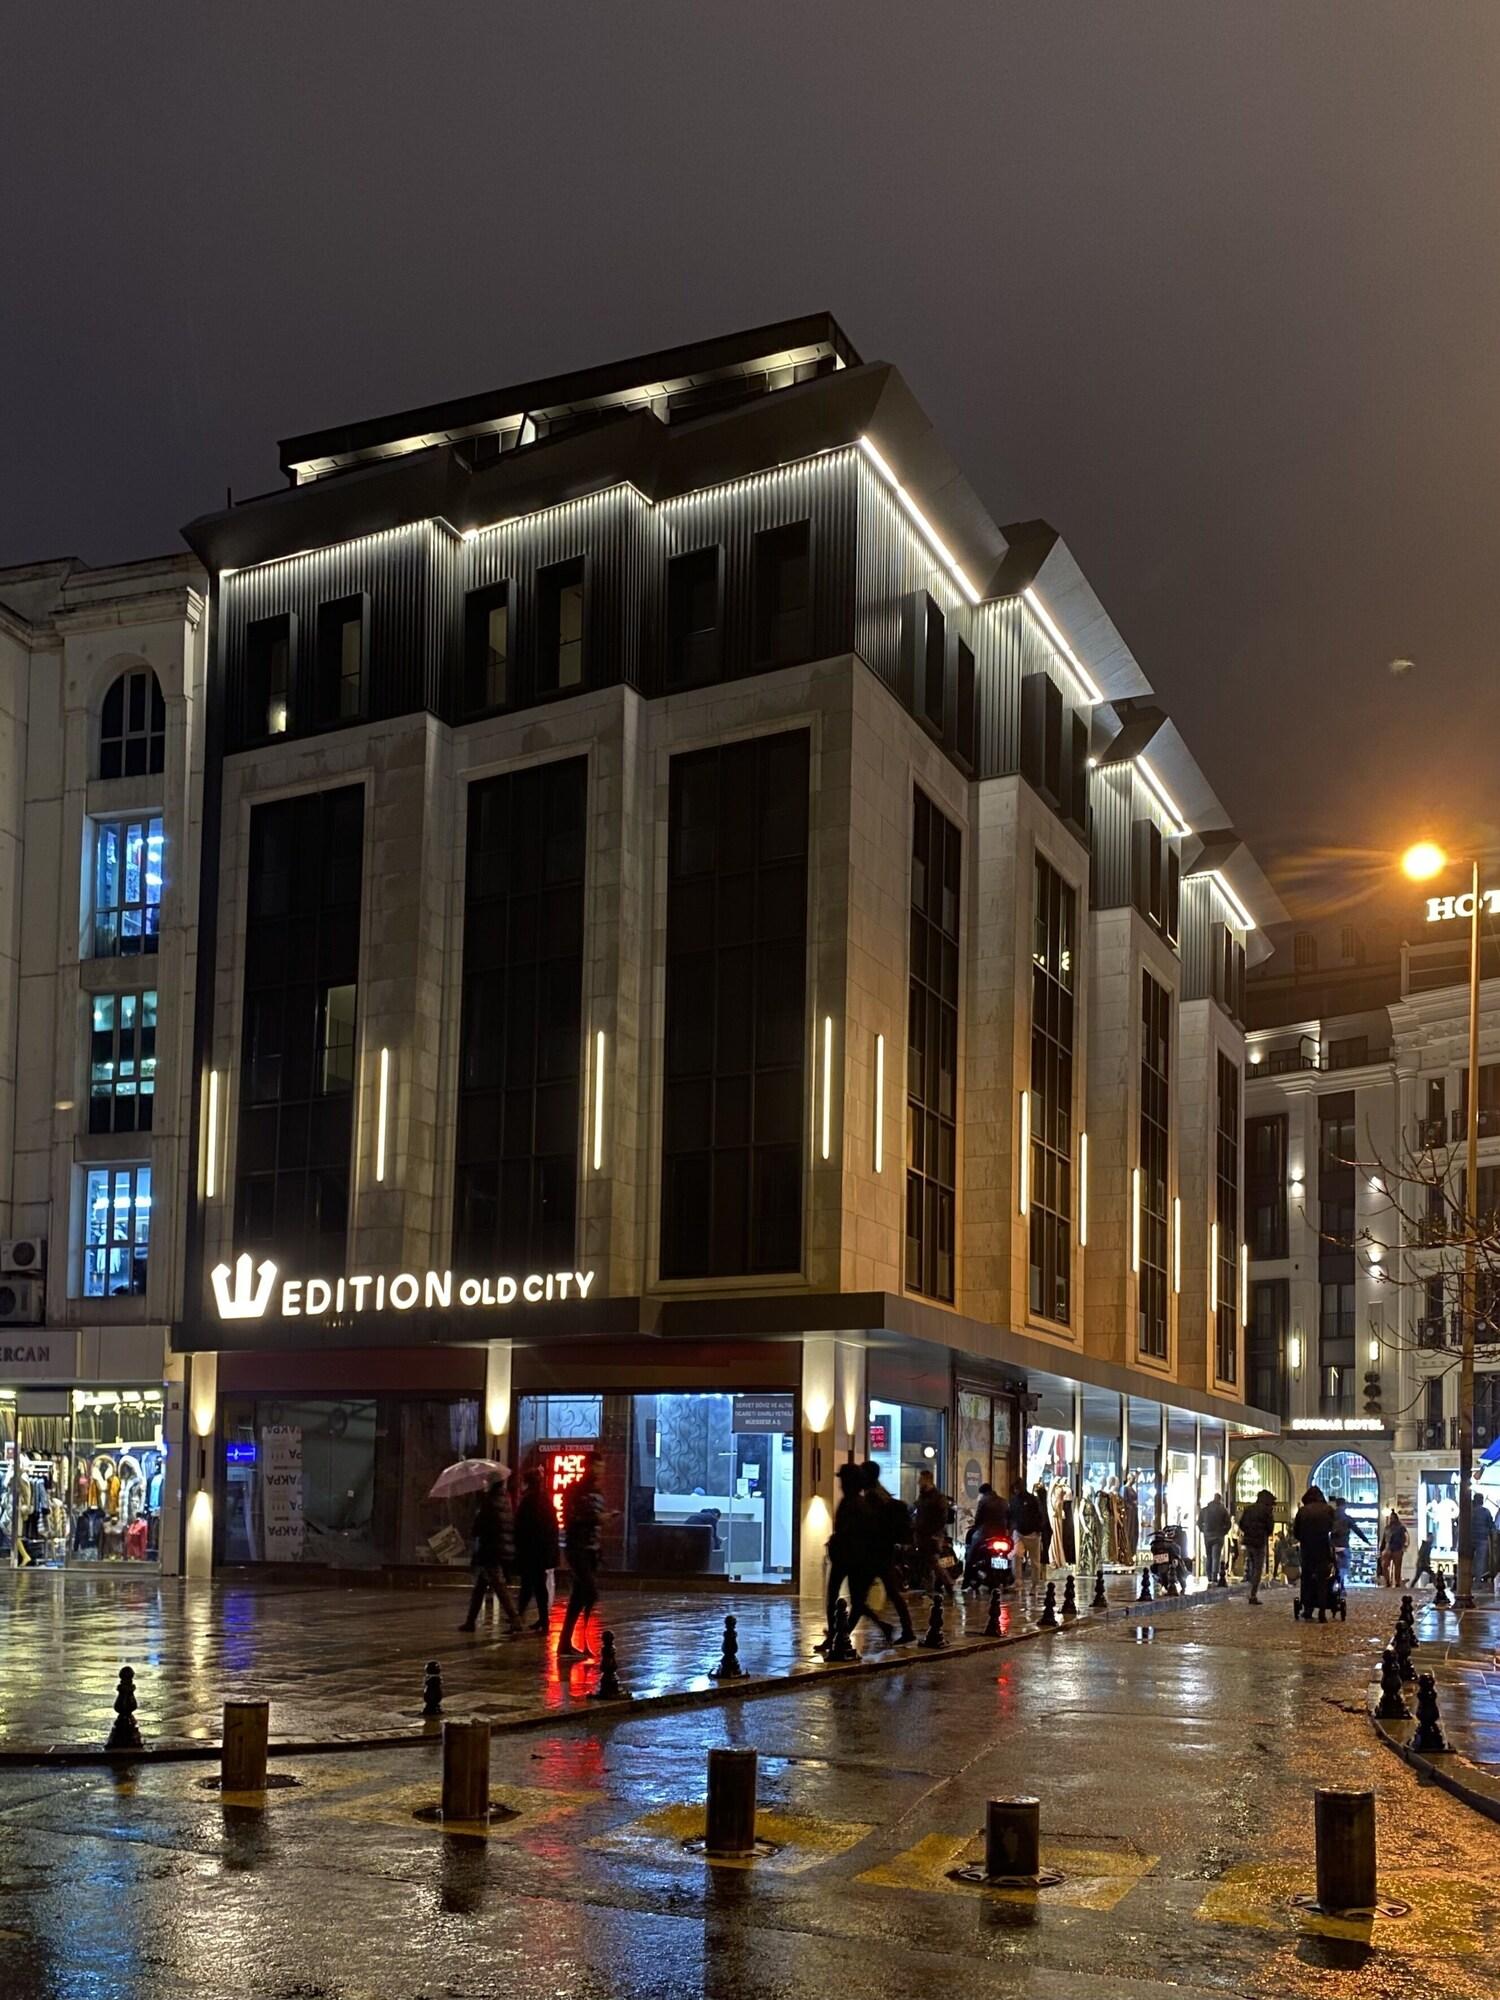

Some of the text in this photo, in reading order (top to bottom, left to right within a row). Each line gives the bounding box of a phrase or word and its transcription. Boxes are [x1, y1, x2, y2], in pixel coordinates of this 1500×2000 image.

[1426, 889, 1500, 922] HOT
[281, 1270, 595, 1316] EDITION OLD CITY
[0, 1345, 50, 1362] RCAN
[266, 1474, 297, 1486] AKPA
[268, 1525, 299, 1536] AKPA
